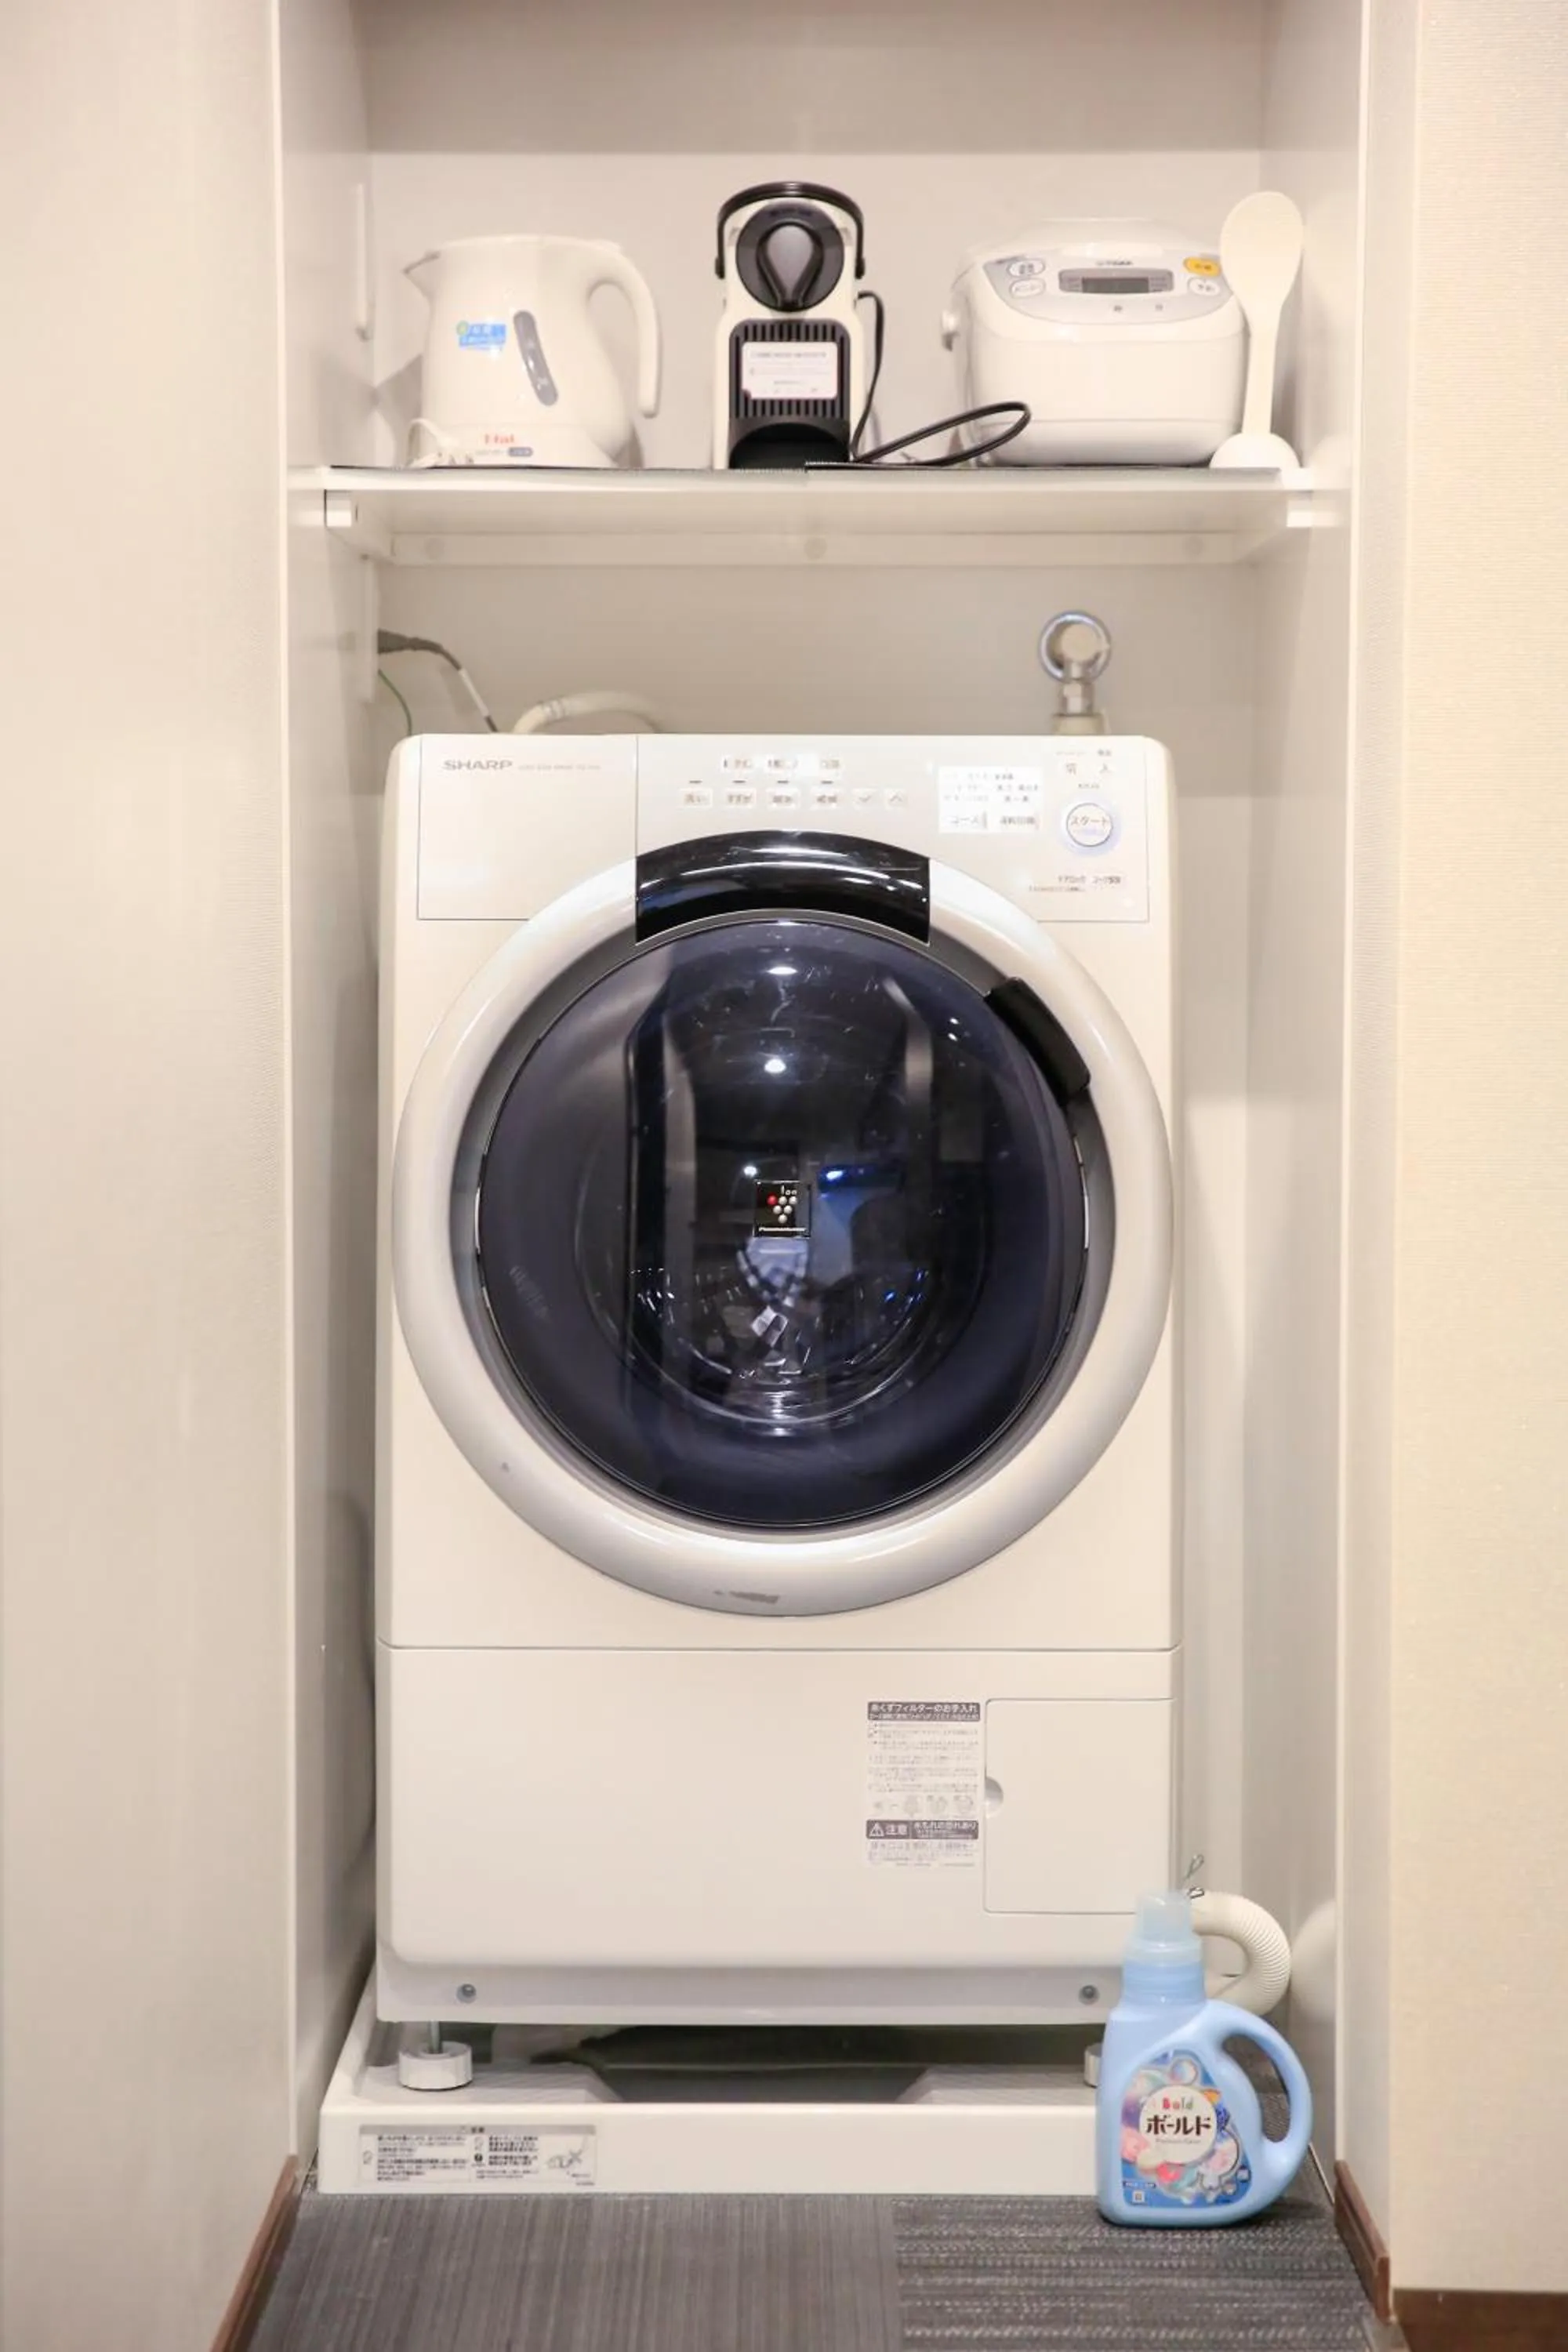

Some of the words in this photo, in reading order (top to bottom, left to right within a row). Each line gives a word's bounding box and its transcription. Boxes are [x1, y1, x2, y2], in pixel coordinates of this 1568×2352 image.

[443, 760, 513, 771] SHARP
[1070, 815, 1110, 826] スタート
[1146, 2114, 1211, 2136] ボールド
